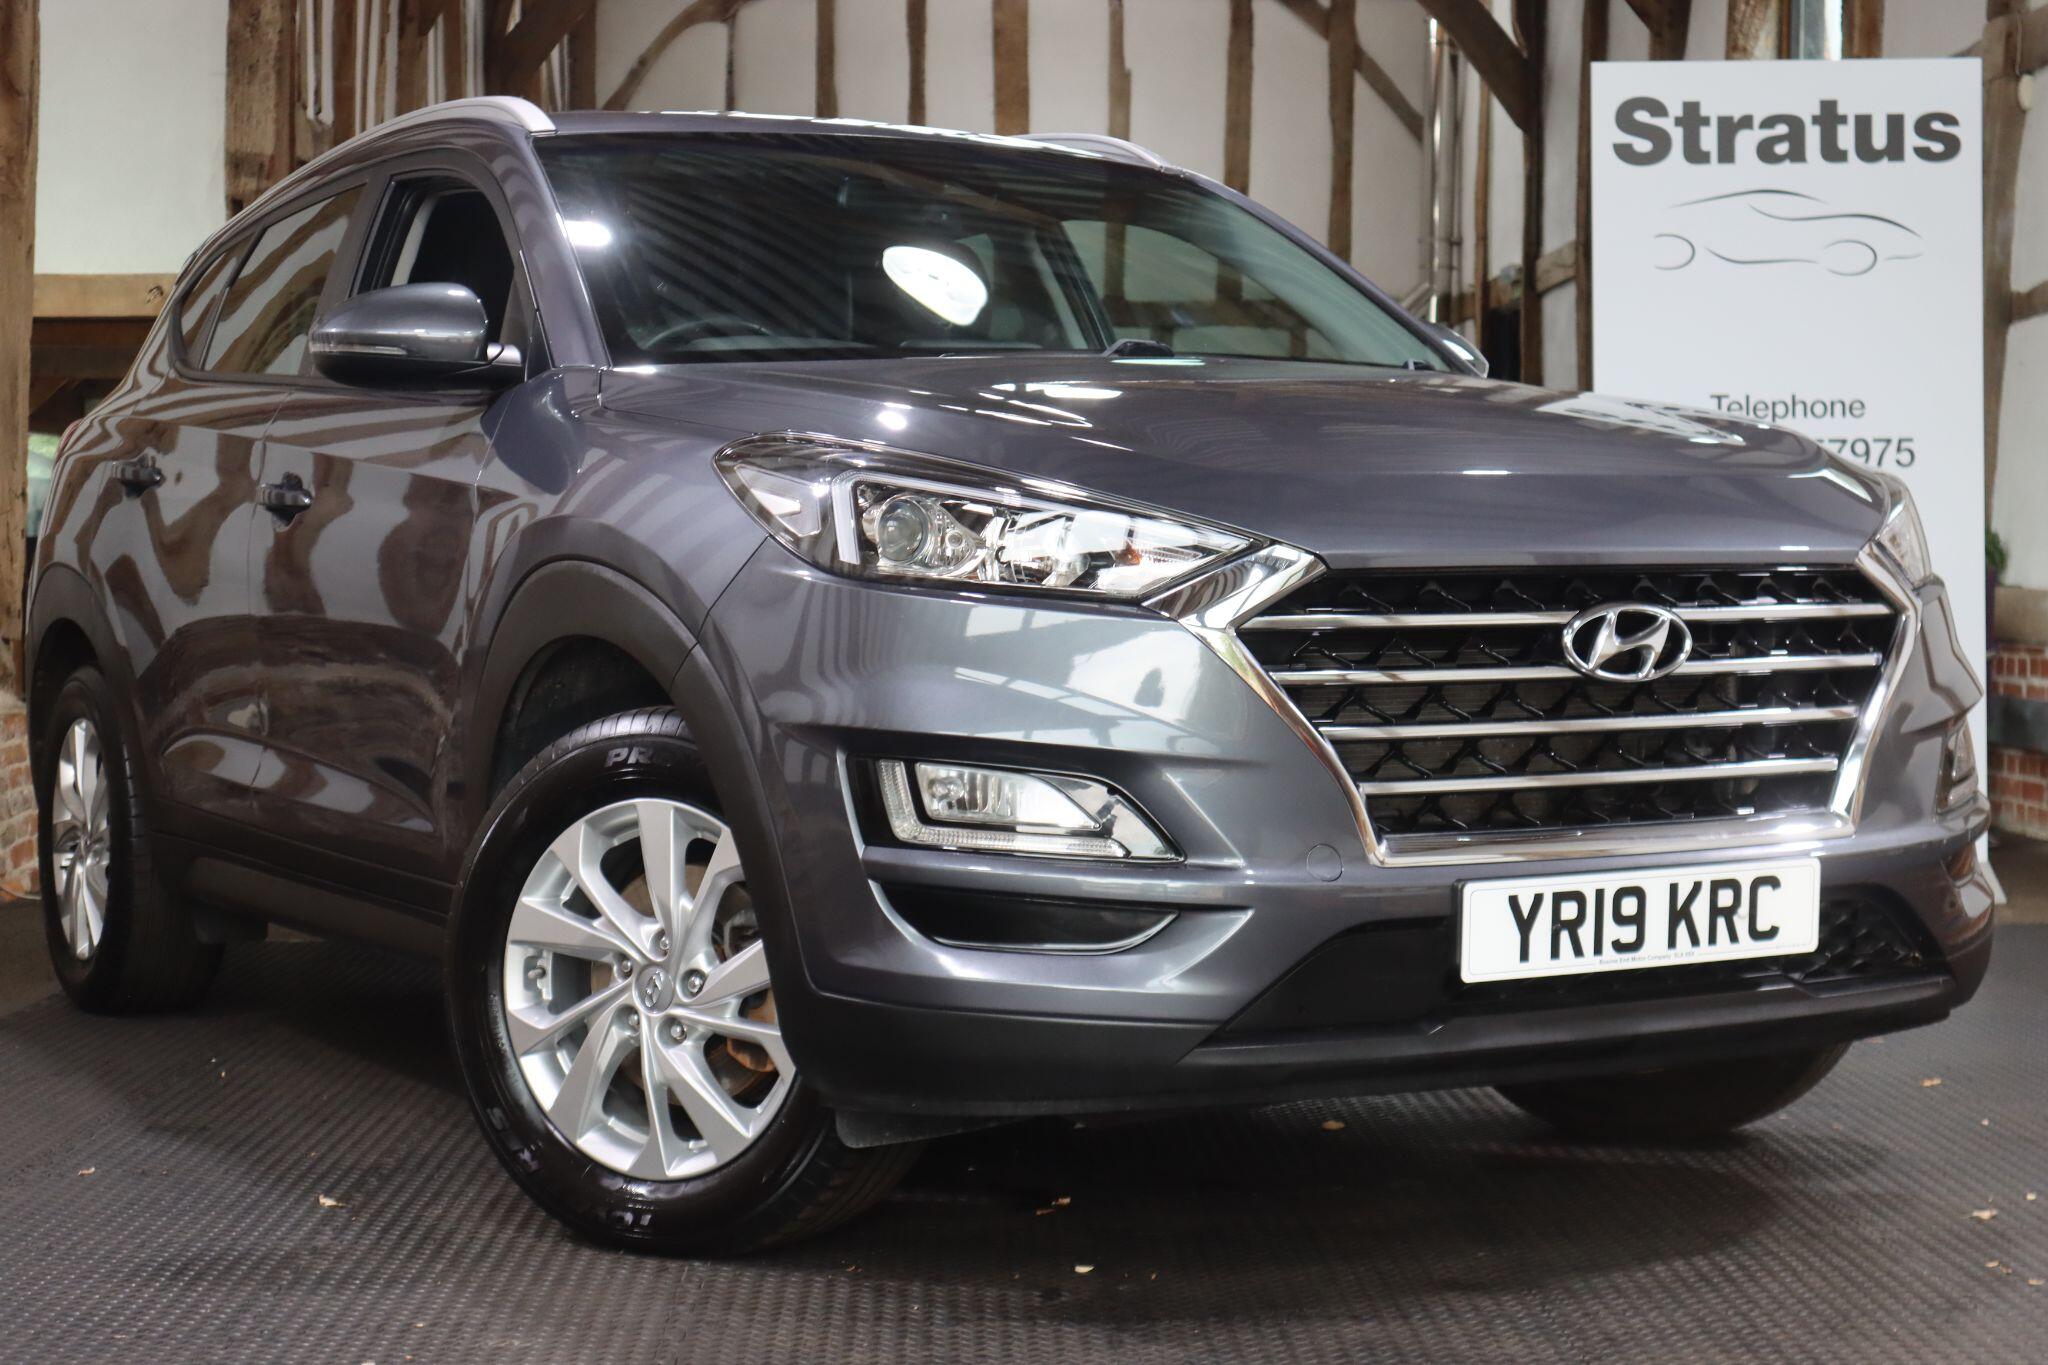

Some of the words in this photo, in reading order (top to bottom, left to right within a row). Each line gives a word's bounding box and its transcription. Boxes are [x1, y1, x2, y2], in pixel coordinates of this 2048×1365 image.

[1612, 96, 1962, 167] Stratus
[1710, 394, 1866, 422] Telephone
[1817, 438, 1915, 467] 7975
[1508, 886, 1647, 963] YR19
[1667, 875, 1781, 950] KRC
